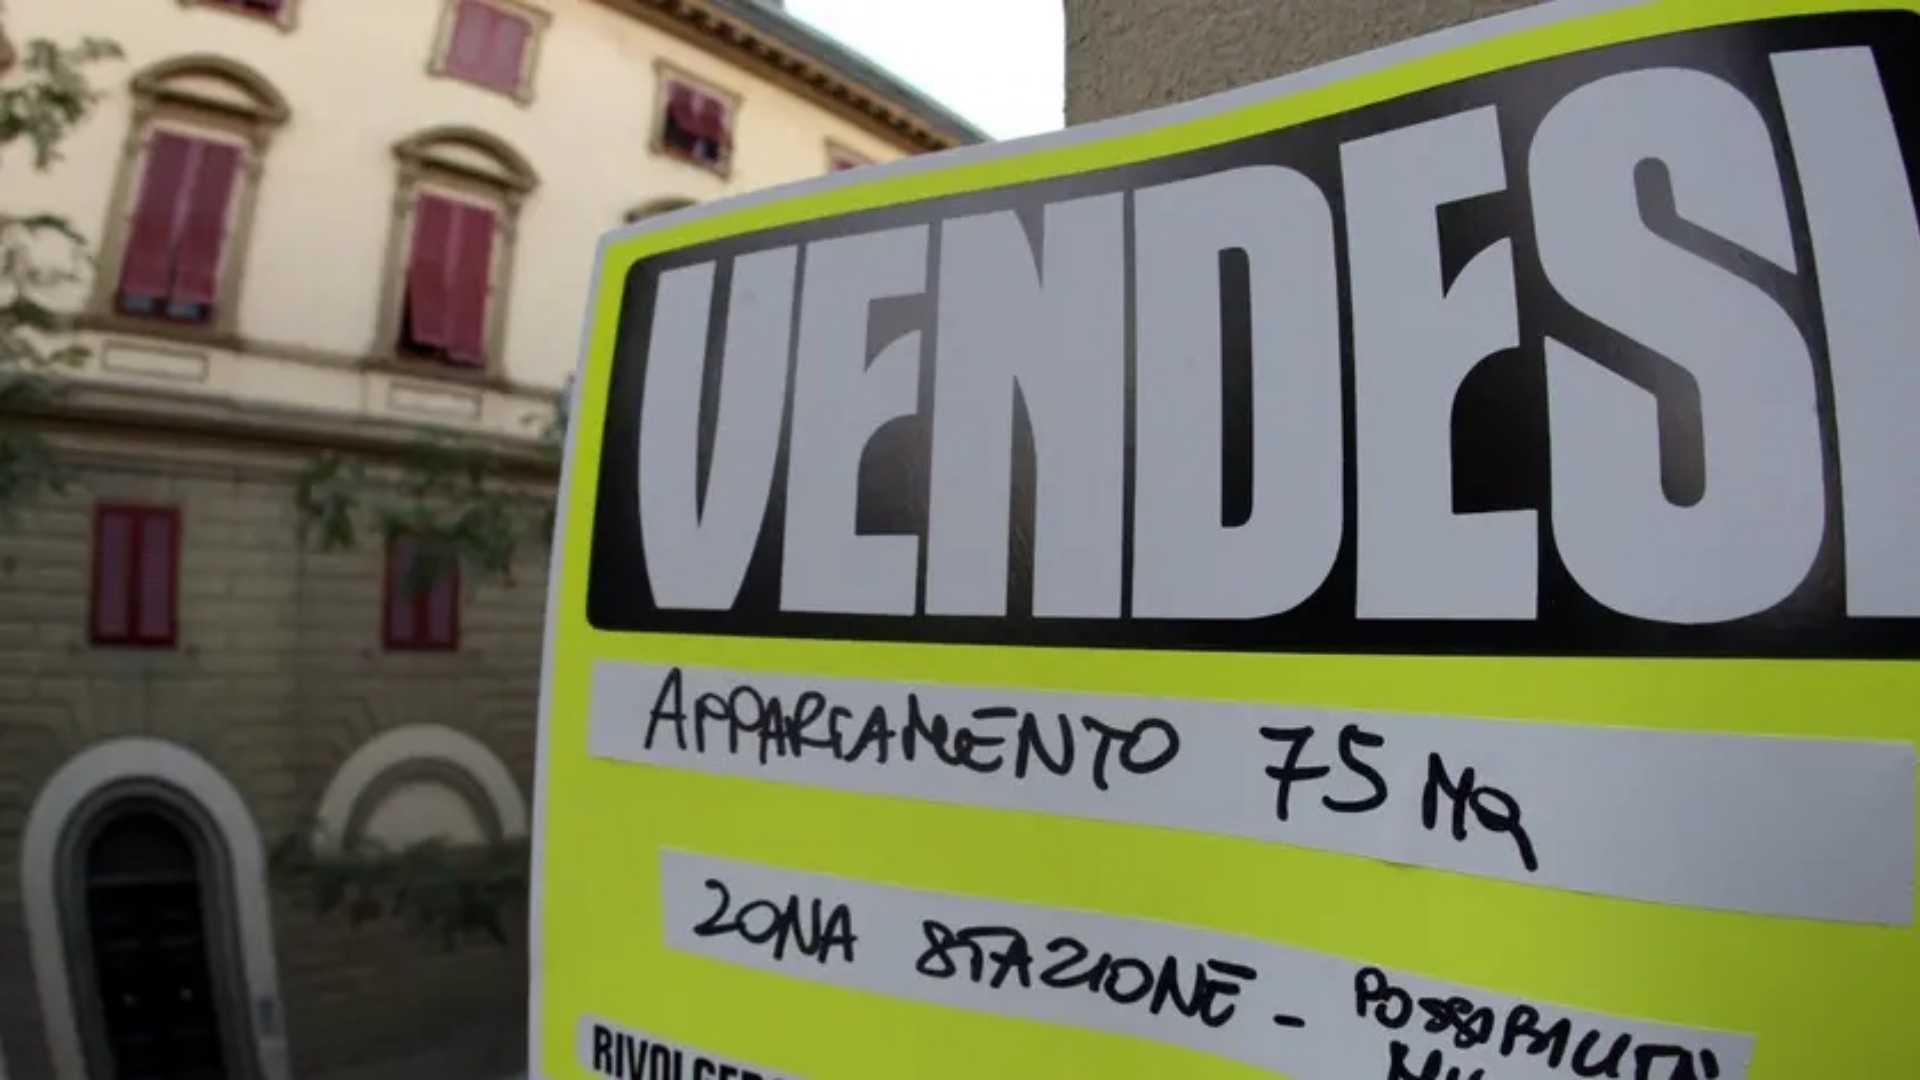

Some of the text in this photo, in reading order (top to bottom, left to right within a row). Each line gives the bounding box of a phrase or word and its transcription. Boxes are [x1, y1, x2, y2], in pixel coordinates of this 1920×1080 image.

[637, 45, 1920, 625] VENDESI
[644, 667, 1180, 790] APPARTAMENTO
[1260, 724, 1388, 821] 75
[694, 878, 857, 962] ZONA
[915, 920, 1257, 1027] STAZIONE
